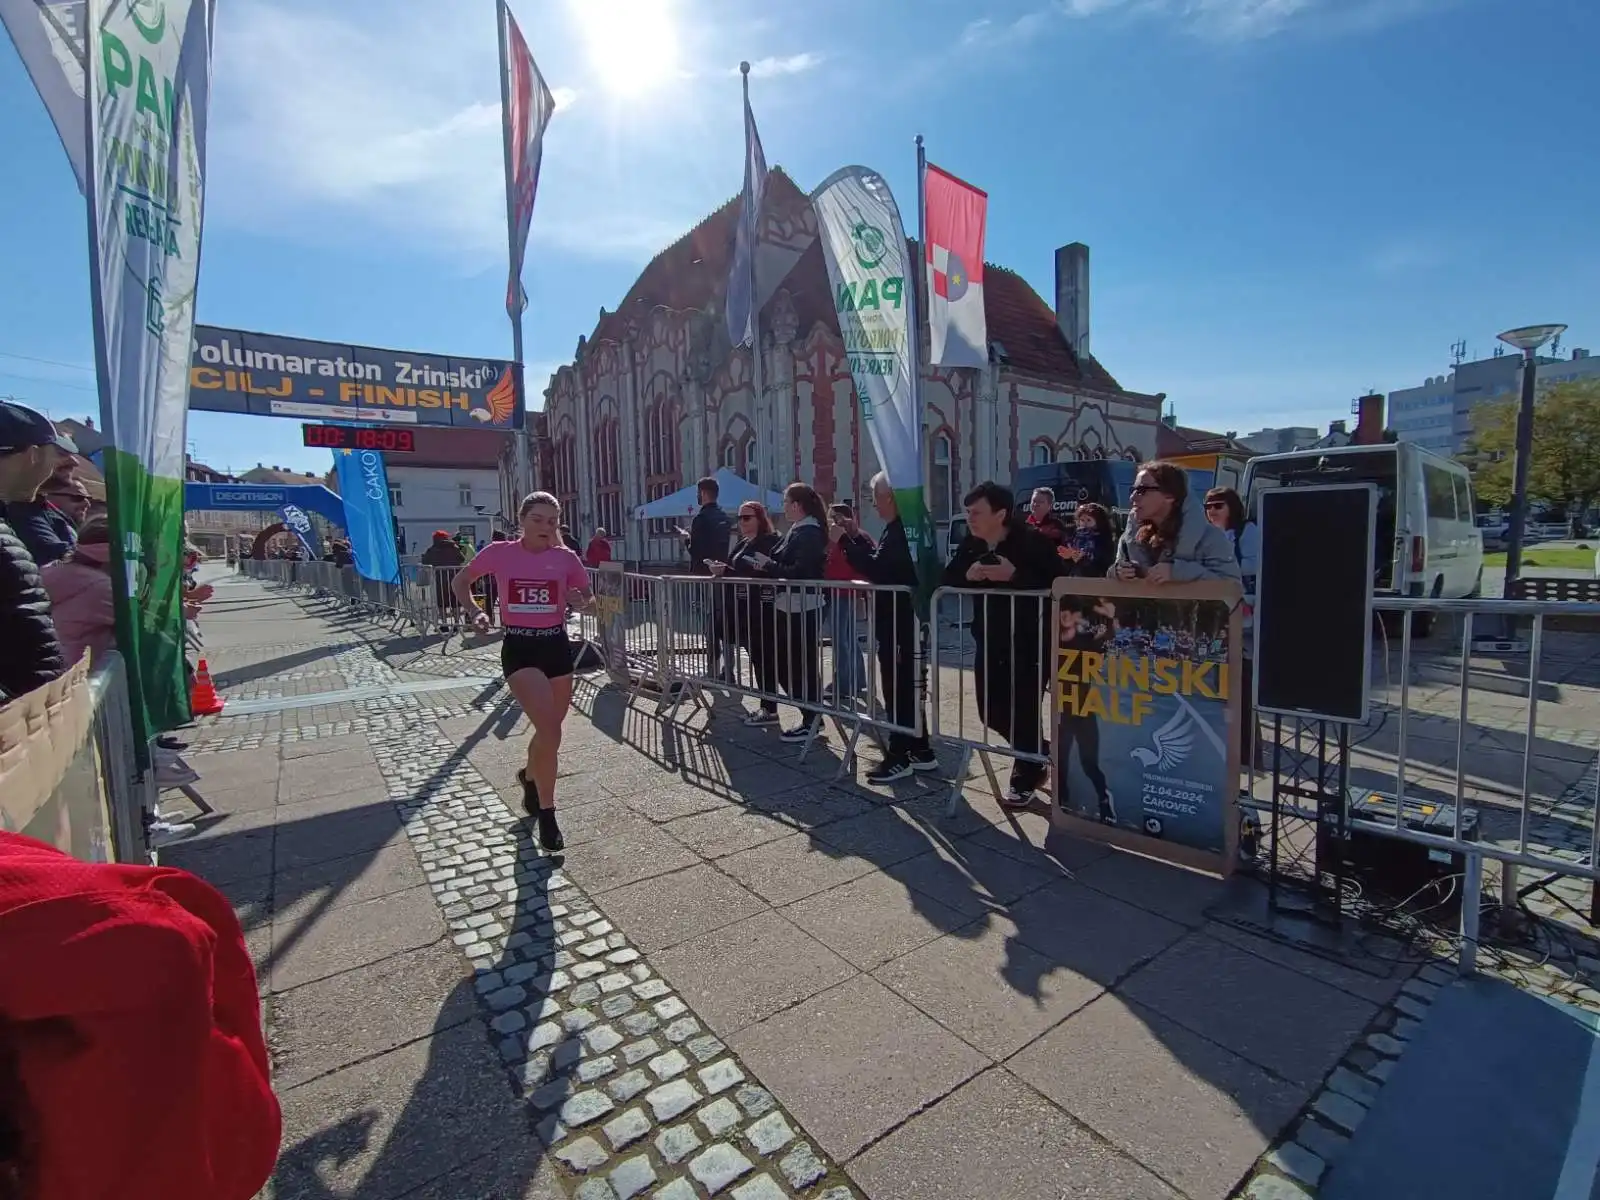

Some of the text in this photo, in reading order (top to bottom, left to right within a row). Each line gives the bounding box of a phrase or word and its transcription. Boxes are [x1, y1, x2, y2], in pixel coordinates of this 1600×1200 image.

[190, 367, 293, 397] CILJ
[339, 382, 469, 410] FINISH
[361, 449, 383, 500] ČAKO
[517, 588, 550, 603] 158
[506, 627, 560, 637] NIKE PRO
[1057, 648, 1229, 700] ZRINSKI
[1057, 682, 1154, 726] HALF
[1142, 794, 1198, 815] ČAKOVEC
